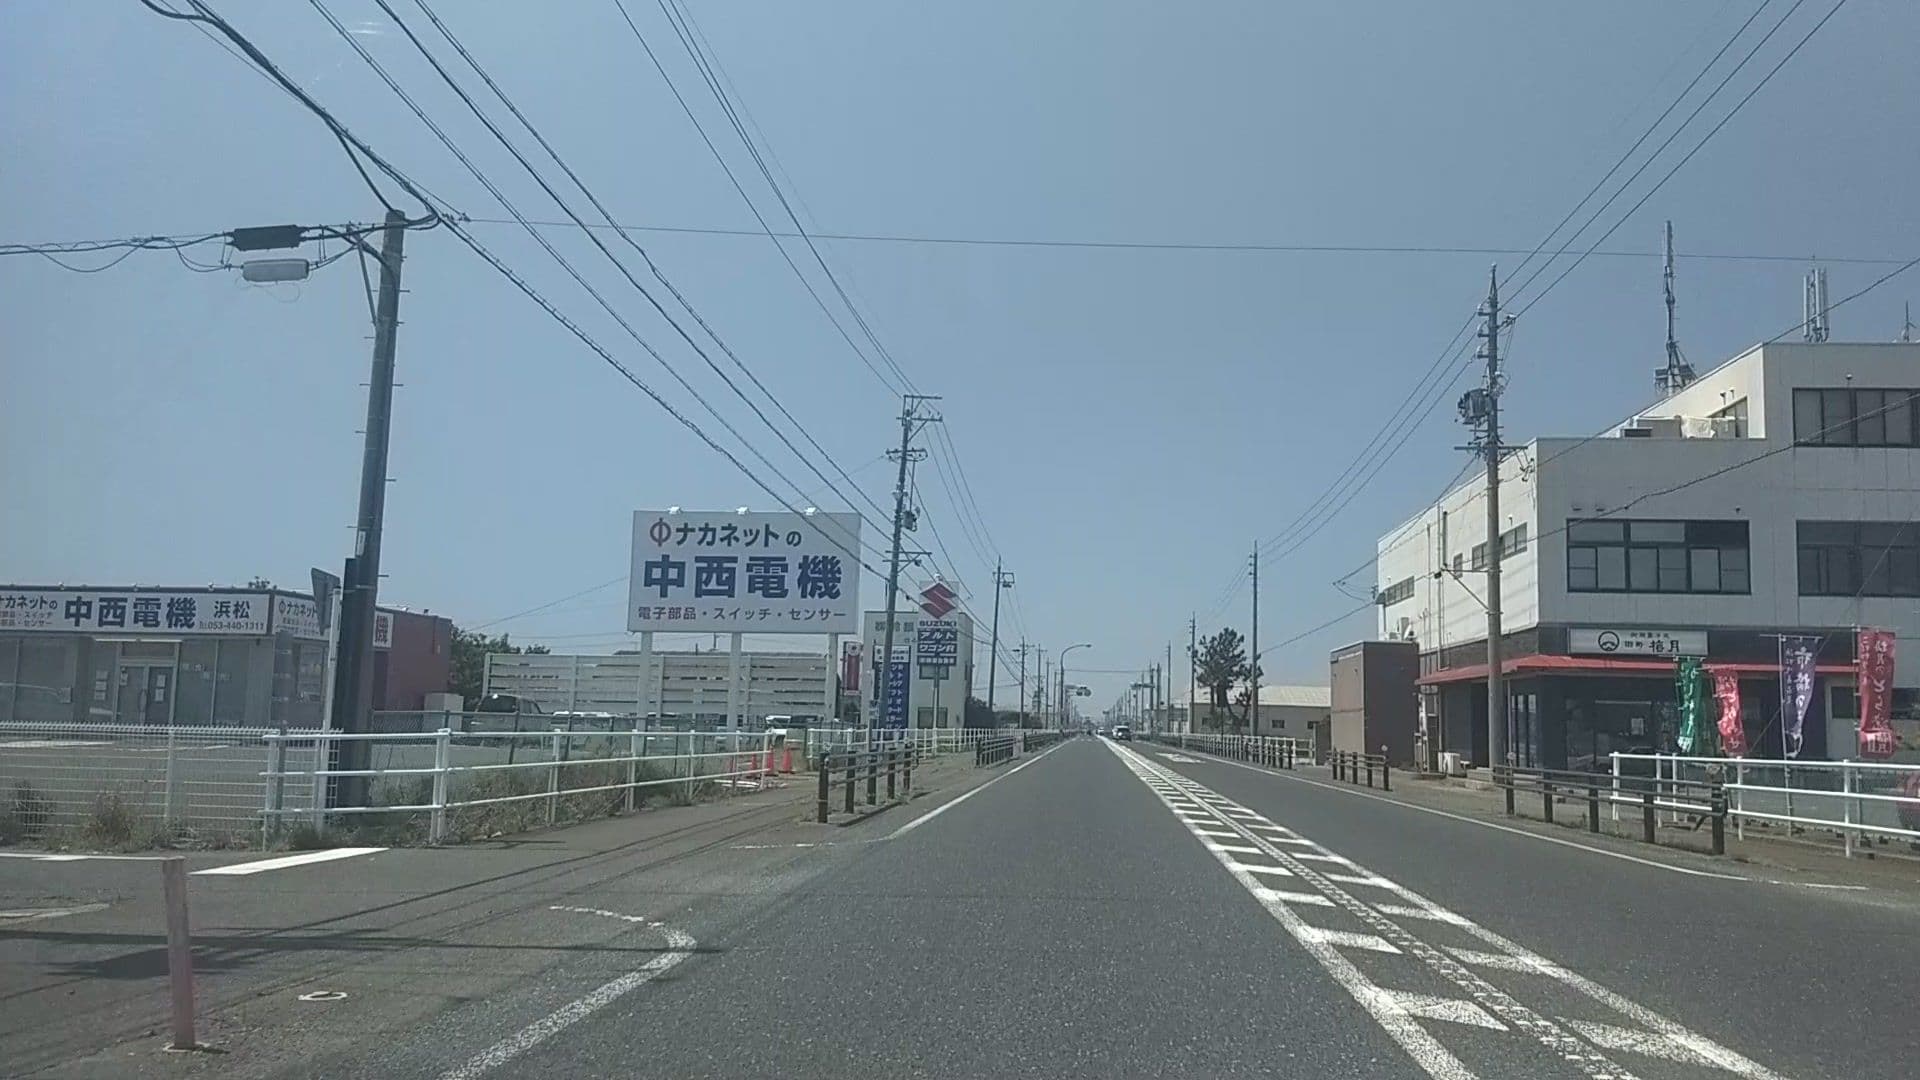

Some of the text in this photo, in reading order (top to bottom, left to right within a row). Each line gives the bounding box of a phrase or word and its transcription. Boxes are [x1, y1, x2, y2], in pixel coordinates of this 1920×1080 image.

[676, 522, 802, 548] ナカネットの
[644, 554, 842, 599] 中西電機
[64, 595, 197, 629] 中西電機
[214, 600, 250, 619] 浜松
[638, 606, 847, 621] 電子部品・スイッチ・センサー
[920, 631, 955, 640] アルト
